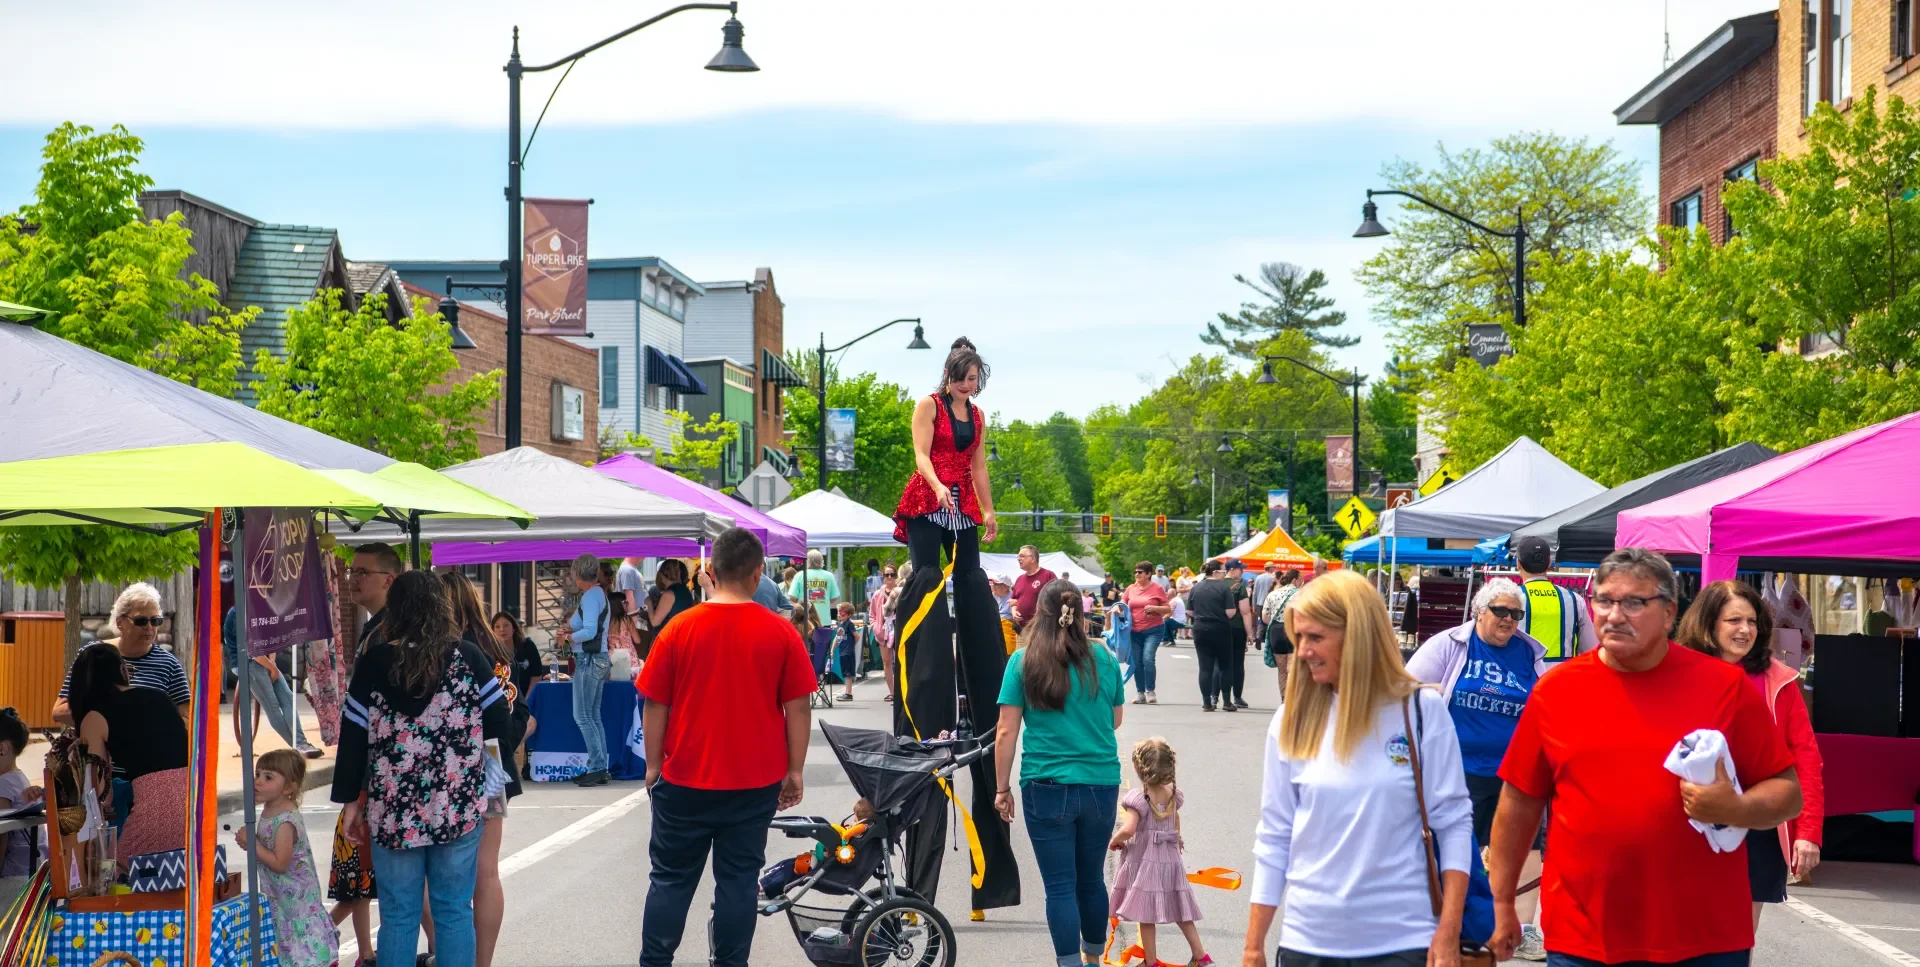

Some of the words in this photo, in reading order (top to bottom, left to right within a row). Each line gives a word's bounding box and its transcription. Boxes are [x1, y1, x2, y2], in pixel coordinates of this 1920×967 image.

[526, 253, 560, 266] TUPPER
[561, 254, 584, 266] LAKE
[526, 307, 550, 321] Park
[549, 307, 582, 324] Street
[1471, 332, 1504, 346] Connect
[1529, 589, 1557, 597] POLICE
[1464, 659, 1528, 693] USA
[1455, 690, 1526, 717] HOCKEY
